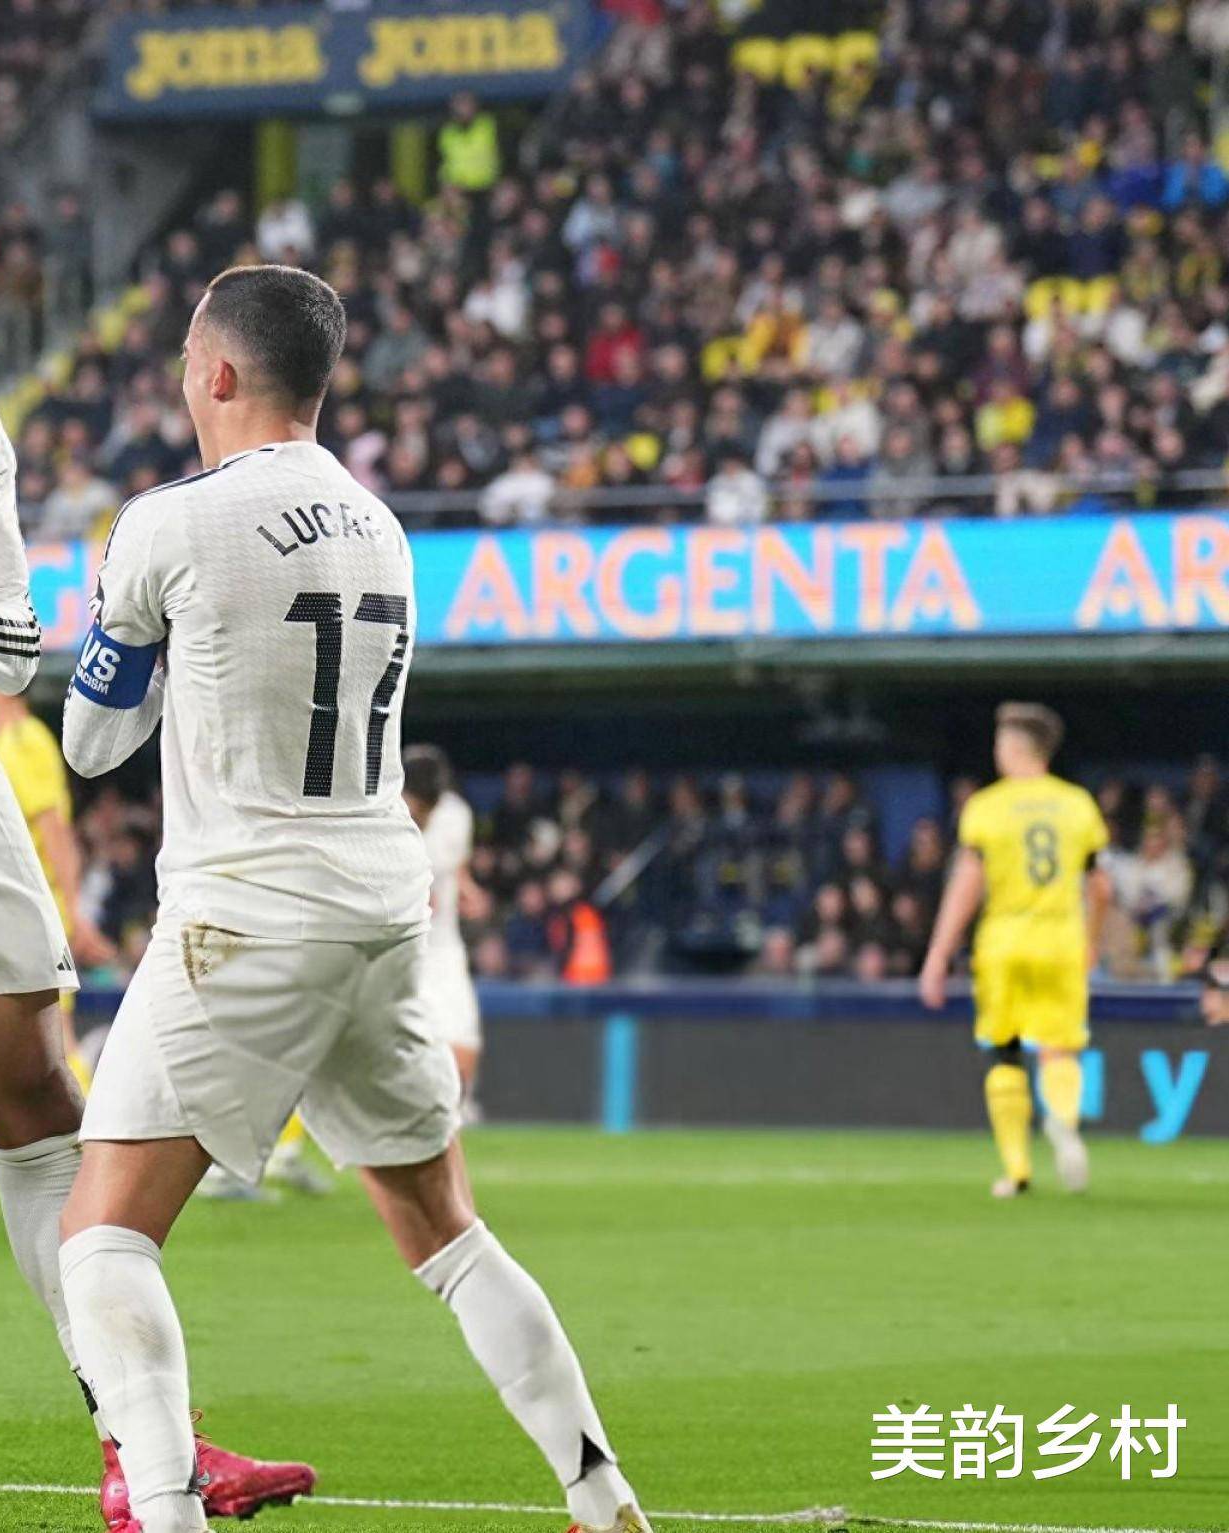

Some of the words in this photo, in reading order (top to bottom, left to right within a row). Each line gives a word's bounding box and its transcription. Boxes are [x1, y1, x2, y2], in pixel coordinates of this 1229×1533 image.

[442, 522, 984, 640] ARGENTA
[1075, 515, 1229, 630] AR
[80, 632, 122, 682] VS
[283, 592, 410, 798] 17
[1024, 823, 1058, 887] 8
